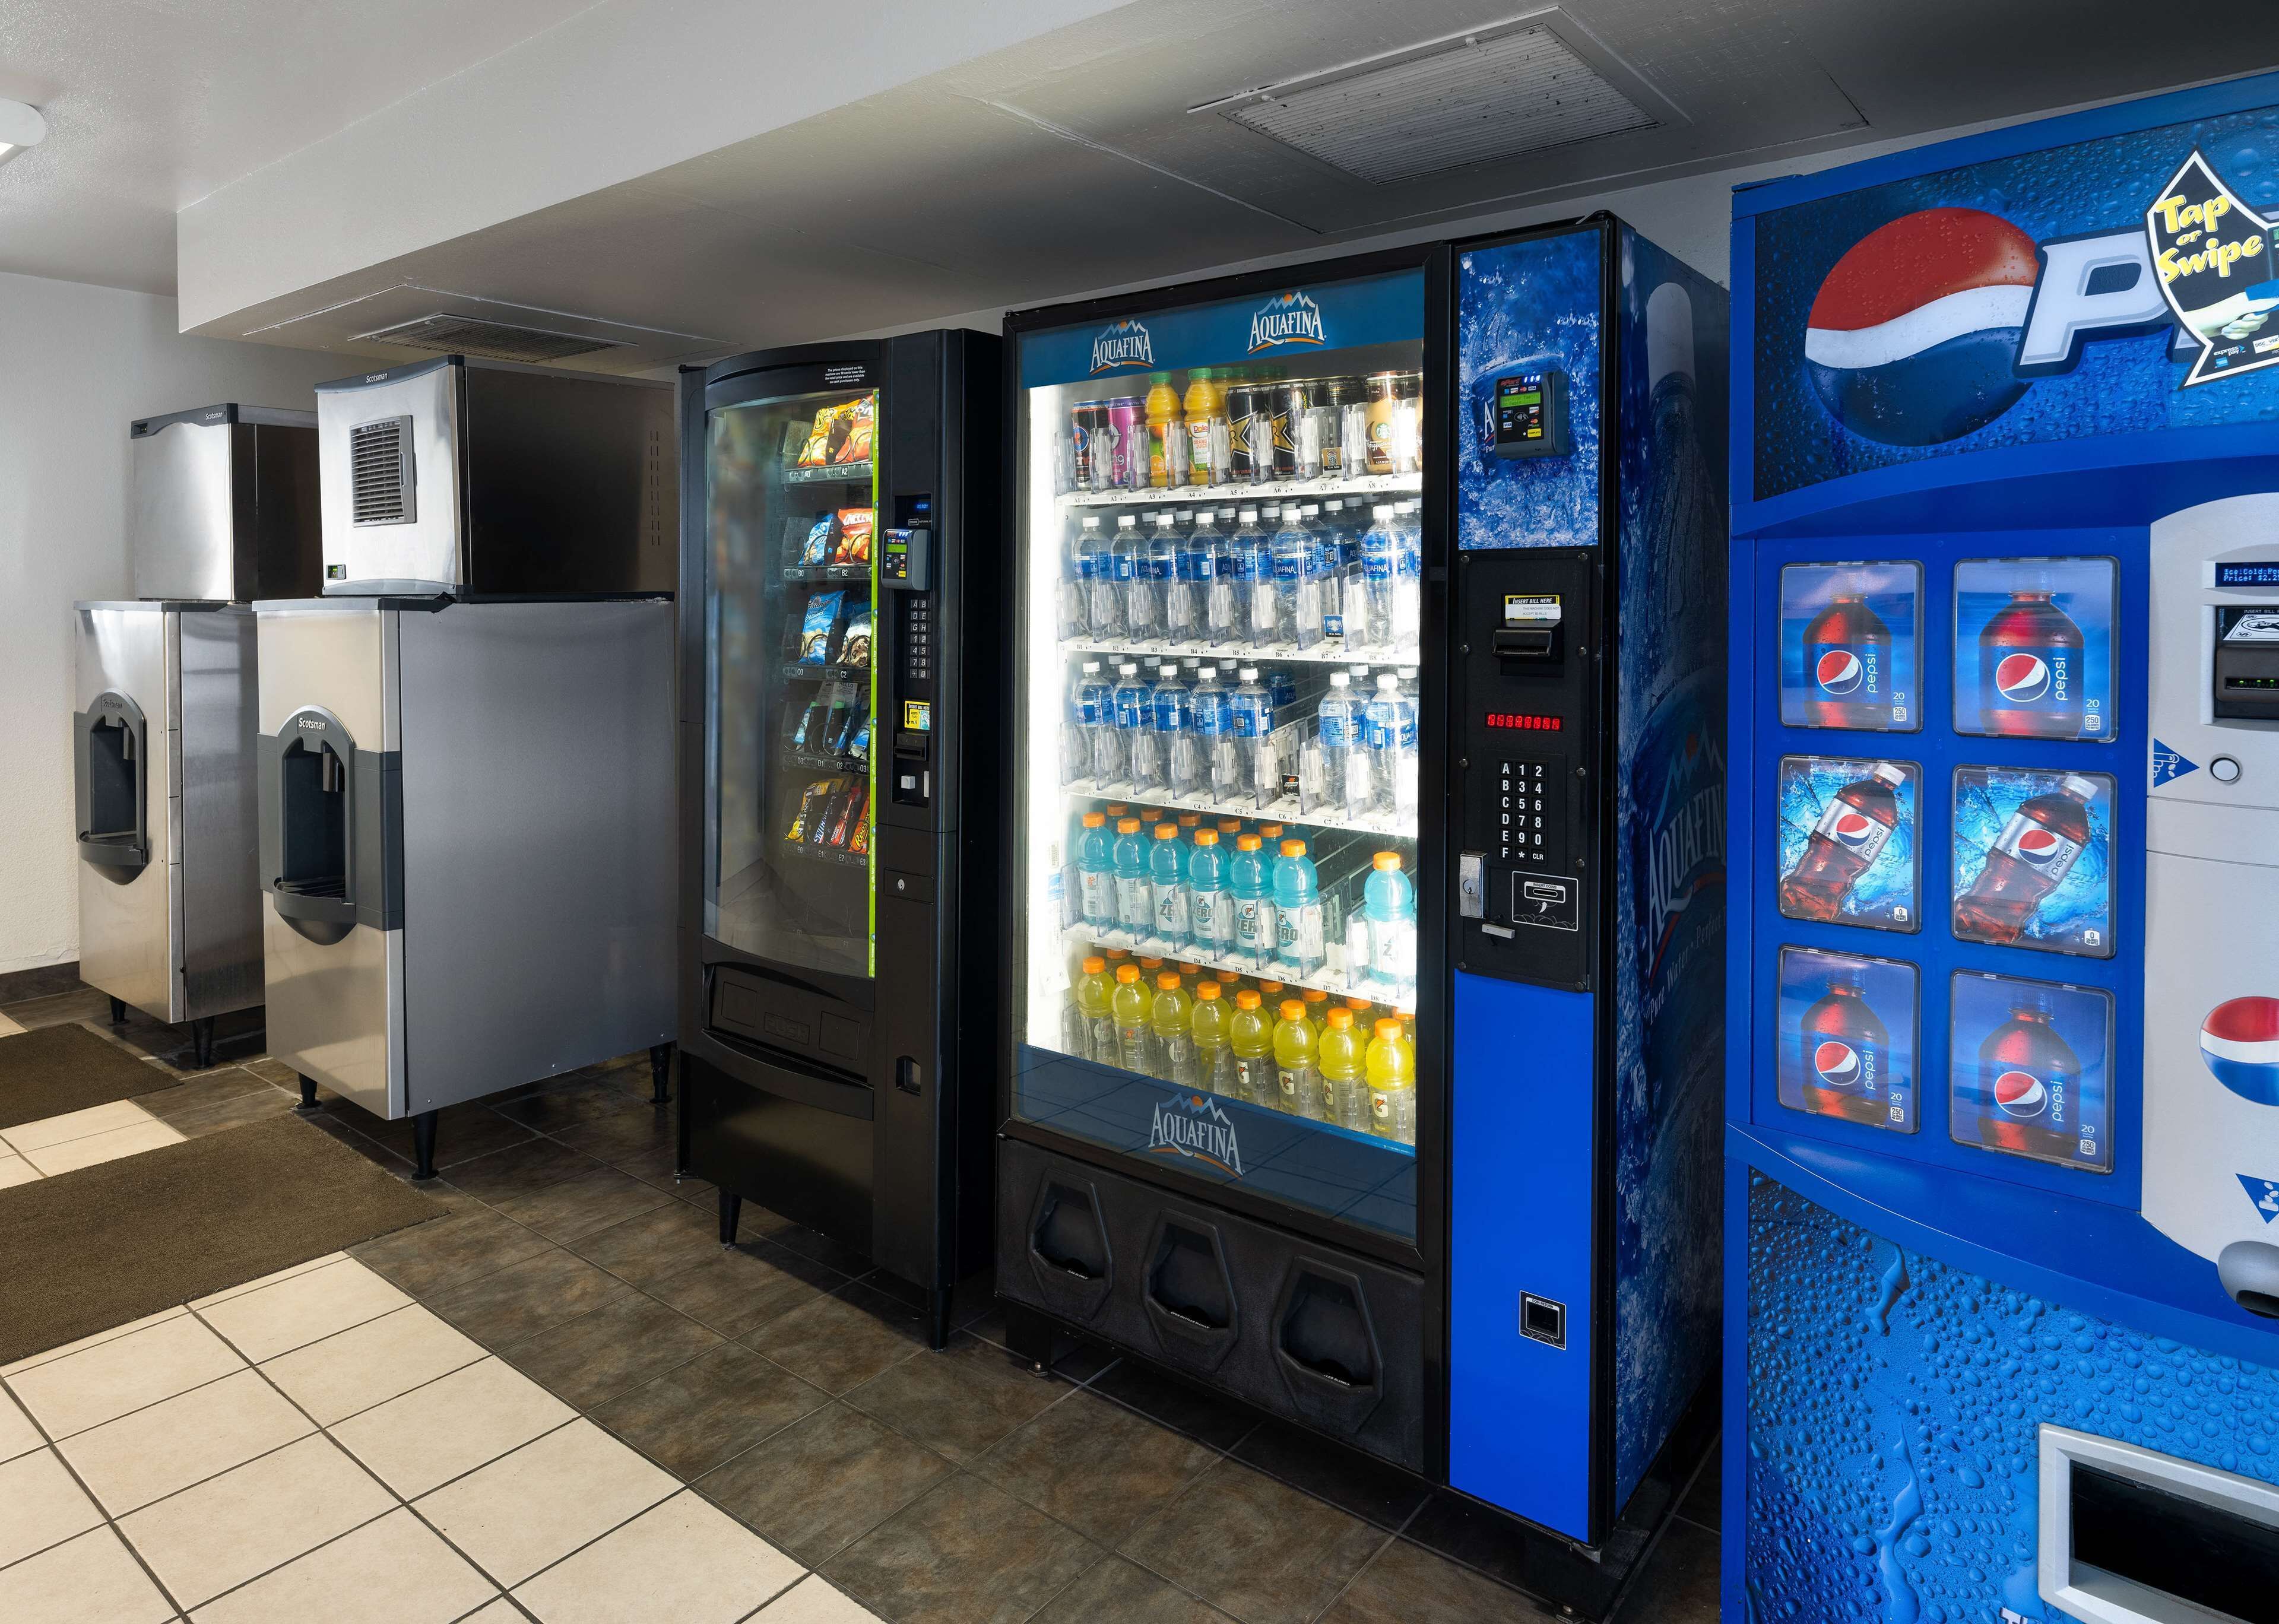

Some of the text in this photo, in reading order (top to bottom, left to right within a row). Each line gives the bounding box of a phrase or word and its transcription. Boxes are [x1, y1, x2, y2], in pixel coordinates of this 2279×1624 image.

[2155, 195, 2231, 233] Tap
[2176, 230, 2202, 246] or
[2157, 235, 2264, 283] Swipe
[1247, 303, 1325, 351] AQUAFINA
[1089, 329, 1153, 373] AQUAFINA
[2214, 345, 2239, 356] express
[366, 373, 388, 383] Scotsman
[205, 412, 223, 420] Scotsman
[1865, 654, 1878, 693] pepsi
[2053, 657, 2068, 700] pepsi
[2086, 699, 2099, 708] 20
[299, 718, 325, 730] Scotsman
[1503, 763, 1542, 776] A 1 2
[1503, 780, 1542, 794] B 3 4
[1503, 797, 1541, 811] C 5 6
[1503, 814, 1541, 828] D 7 8
[1503, 830, 1541, 845] E 9 0
[1865, 827, 1885, 857] pepsi
[1503, 847, 1508, 858] F
[2051, 843, 2074, 876] pepsi
[1649, 784, 1726, 978] AQUAFIN
[1863, 1050, 1876, 1090] pepsi
[1891, 1092, 1902, 1101] 20
[2050, 1080, 2065, 1122] pepsi
[2081, 1124, 2094, 1134] 20
[1148, 1102, 1243, 1175] AQUAFINA
[2083, 1140, 2094, 1149] 250
